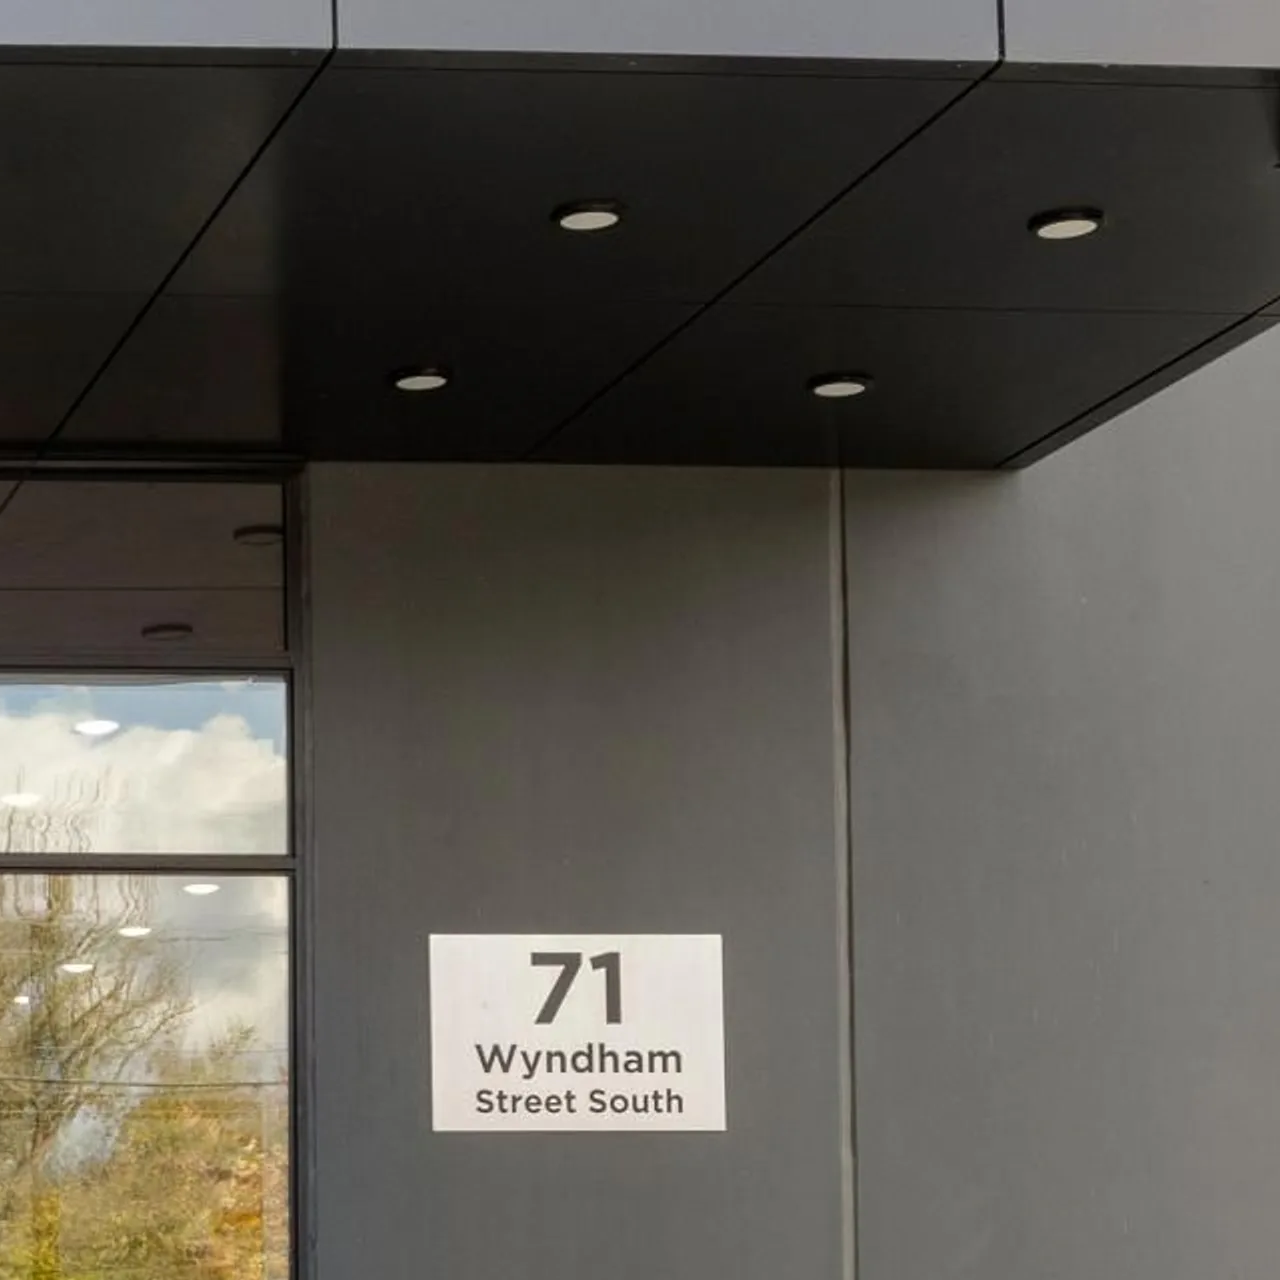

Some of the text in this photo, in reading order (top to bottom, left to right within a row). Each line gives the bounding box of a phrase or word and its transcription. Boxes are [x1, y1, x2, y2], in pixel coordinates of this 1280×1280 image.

[529, 951, 623, 1025] 71
[475, 1043, 682, 1079] Wyndham
[476, 1089, 684, 1114] Street South
